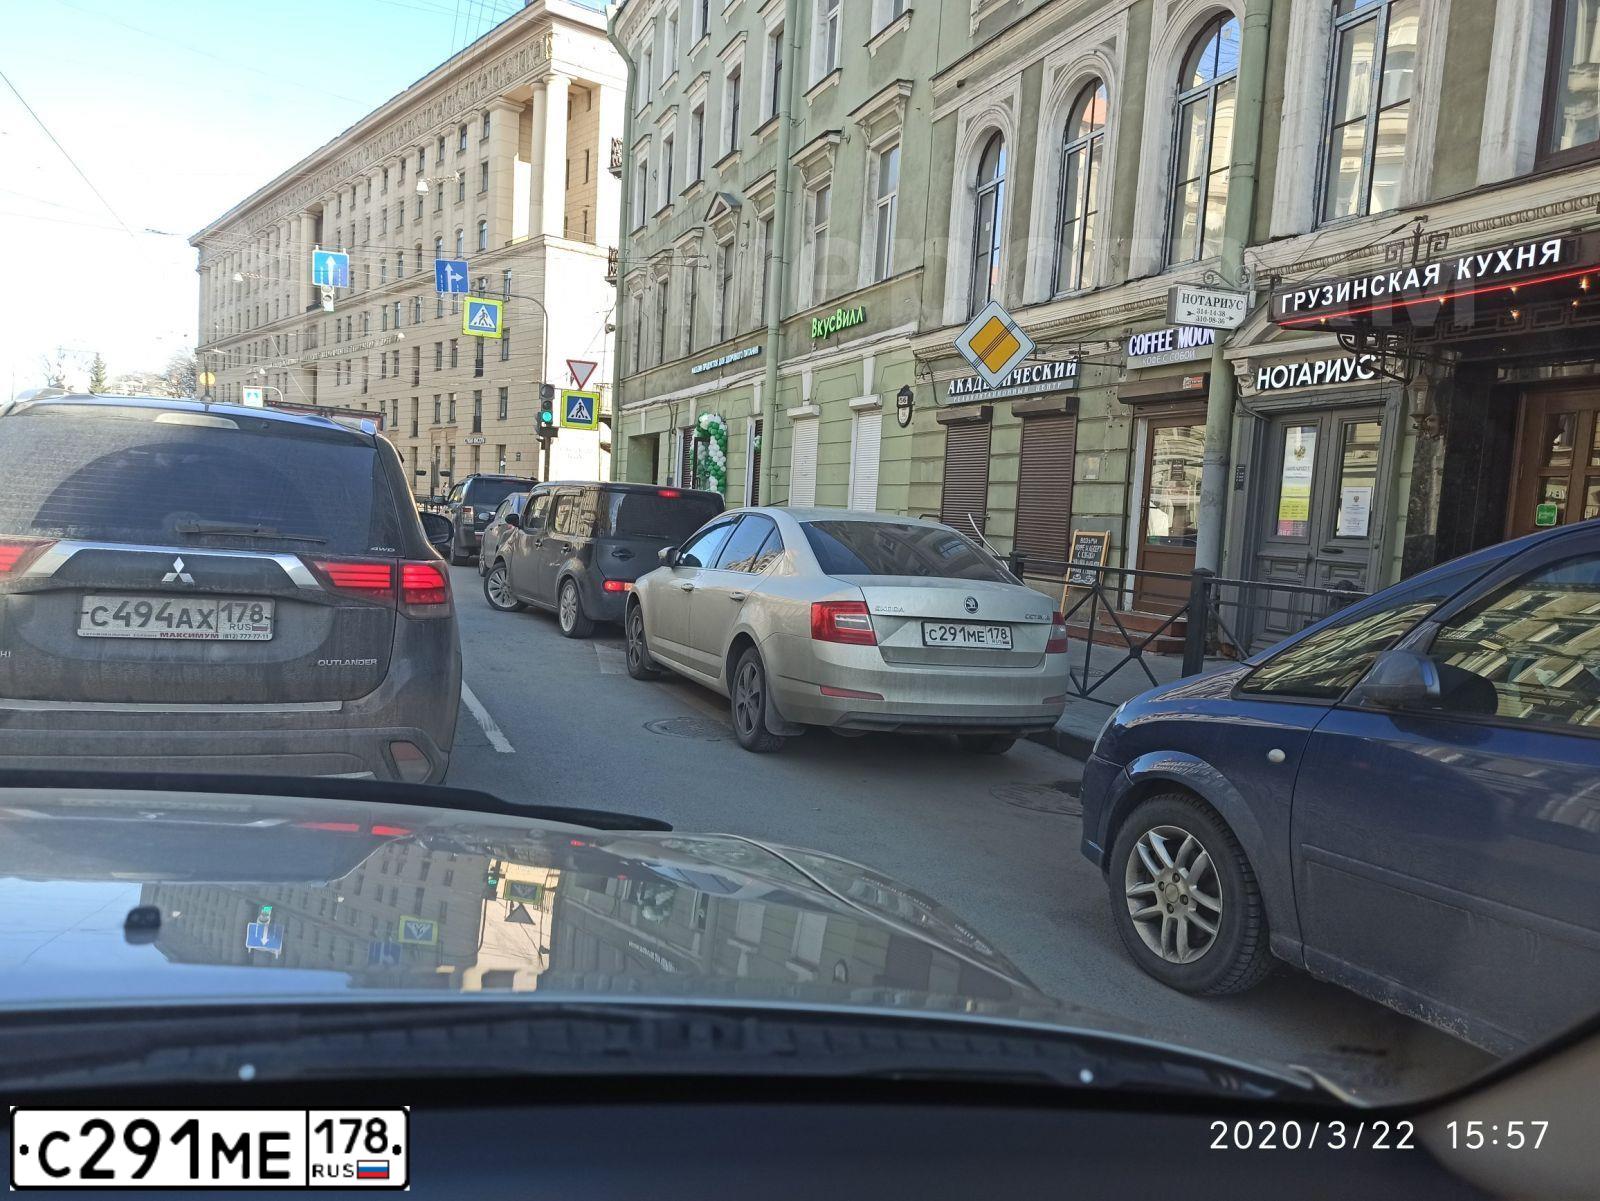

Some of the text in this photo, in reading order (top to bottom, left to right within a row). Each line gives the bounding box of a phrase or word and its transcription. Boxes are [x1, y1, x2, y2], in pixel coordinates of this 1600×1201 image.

[1281, 238, 1562, 313] ГРУЗИНСКАЯ КУХНЯ
[1182, 293, 1243, 310] НОТАРИУС
[1128, 329, 1174, 356] COFFEE
[948, 356, 1078, 394] АКАДЕИЧЕСКИЙ
[1256, 354, 1377, 390] НОТАРИУС
[221, 602, 264, 623] 178
[988, 627, 1007, 639] 178
[318, 658, 378, 666] OUTLANDER
